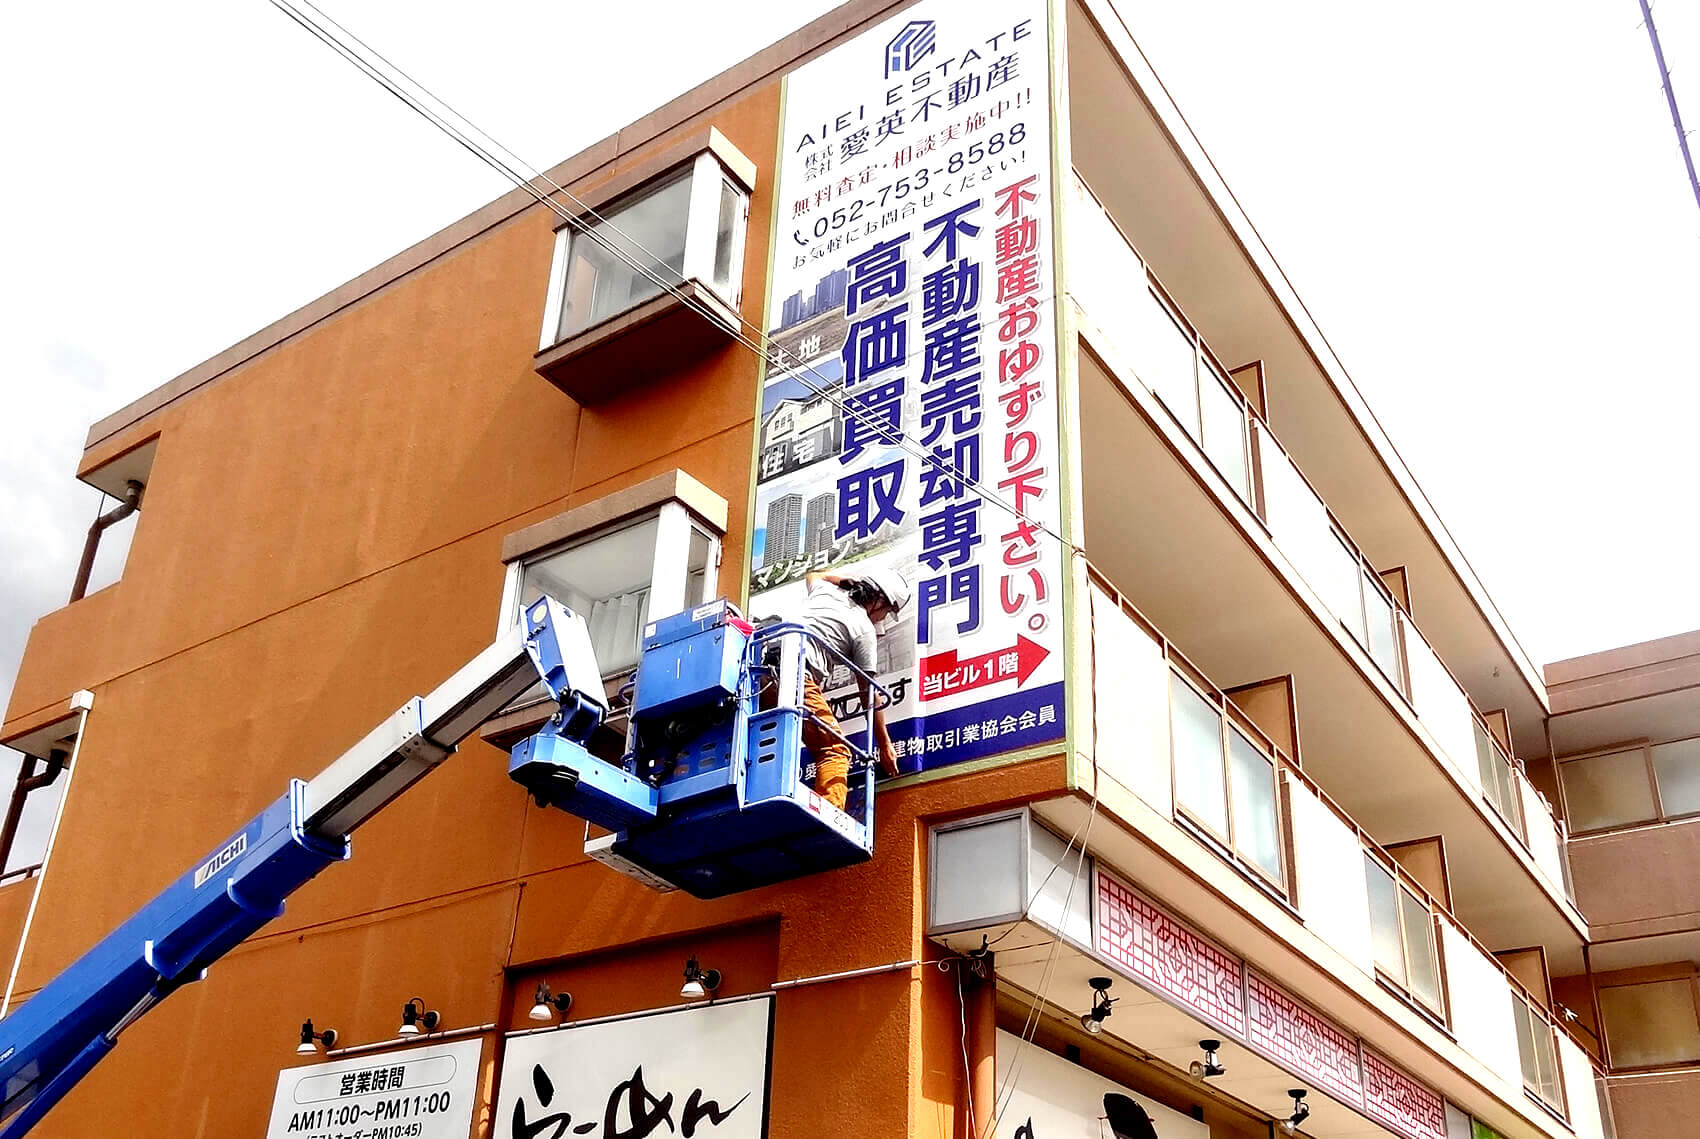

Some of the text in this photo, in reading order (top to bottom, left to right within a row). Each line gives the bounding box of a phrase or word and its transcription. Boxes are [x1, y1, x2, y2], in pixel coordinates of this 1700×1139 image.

[796, 19, 1032, 152] AIEI ESTATE
[840, 51, 1021, 165] 愛英不動産
[814, 122, 1026, 238] 052-753-8588
[768, 334, 822, 375] 土地
[834, 232, 911, 540] 高価買取
[916, 199, 982, 644] 不動産売却専門
[994, 174, 1047, 632] 不動産おゆずり下さい。
[761, 438, 816, 480] 住宅
[755, 540, 851, 588] マンション
[922, 652, 1020, 696] 当ビル1階
[204, 837, 245, 879] AICHI
[339, 1065, 406, 1097] 営業時間
